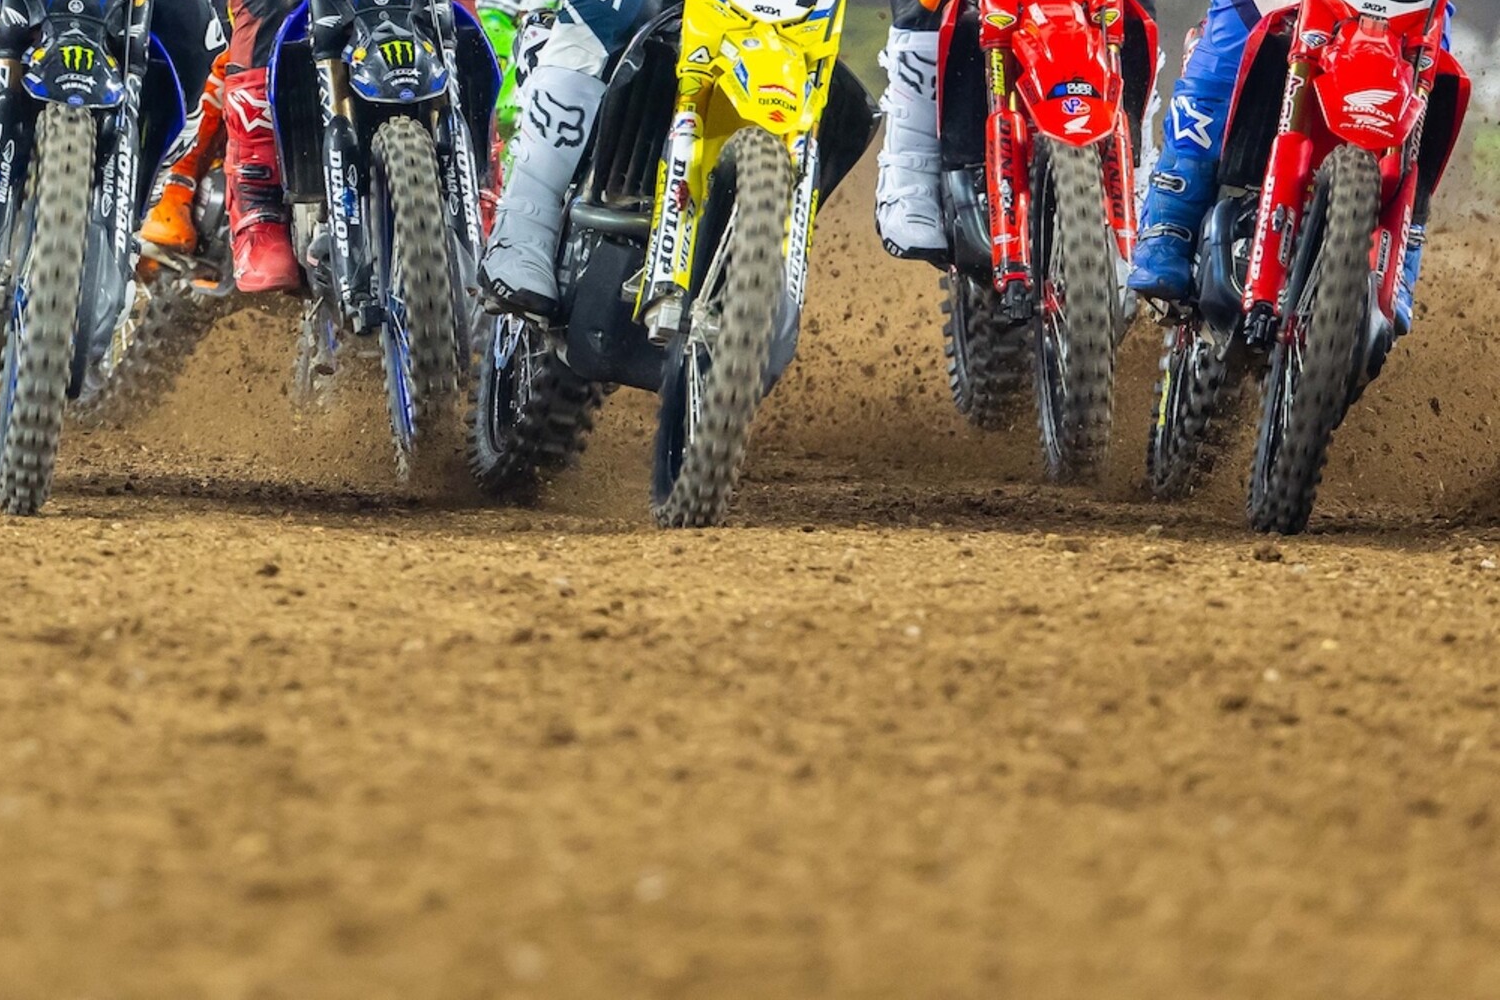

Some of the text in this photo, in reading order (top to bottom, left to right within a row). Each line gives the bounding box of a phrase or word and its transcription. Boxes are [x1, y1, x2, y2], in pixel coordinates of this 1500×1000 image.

[1341, 105, 1395, 121] HONDA
[329, 150, 348, 258] DUNLOP
[659, 156, 687, 275] DUNLOP
